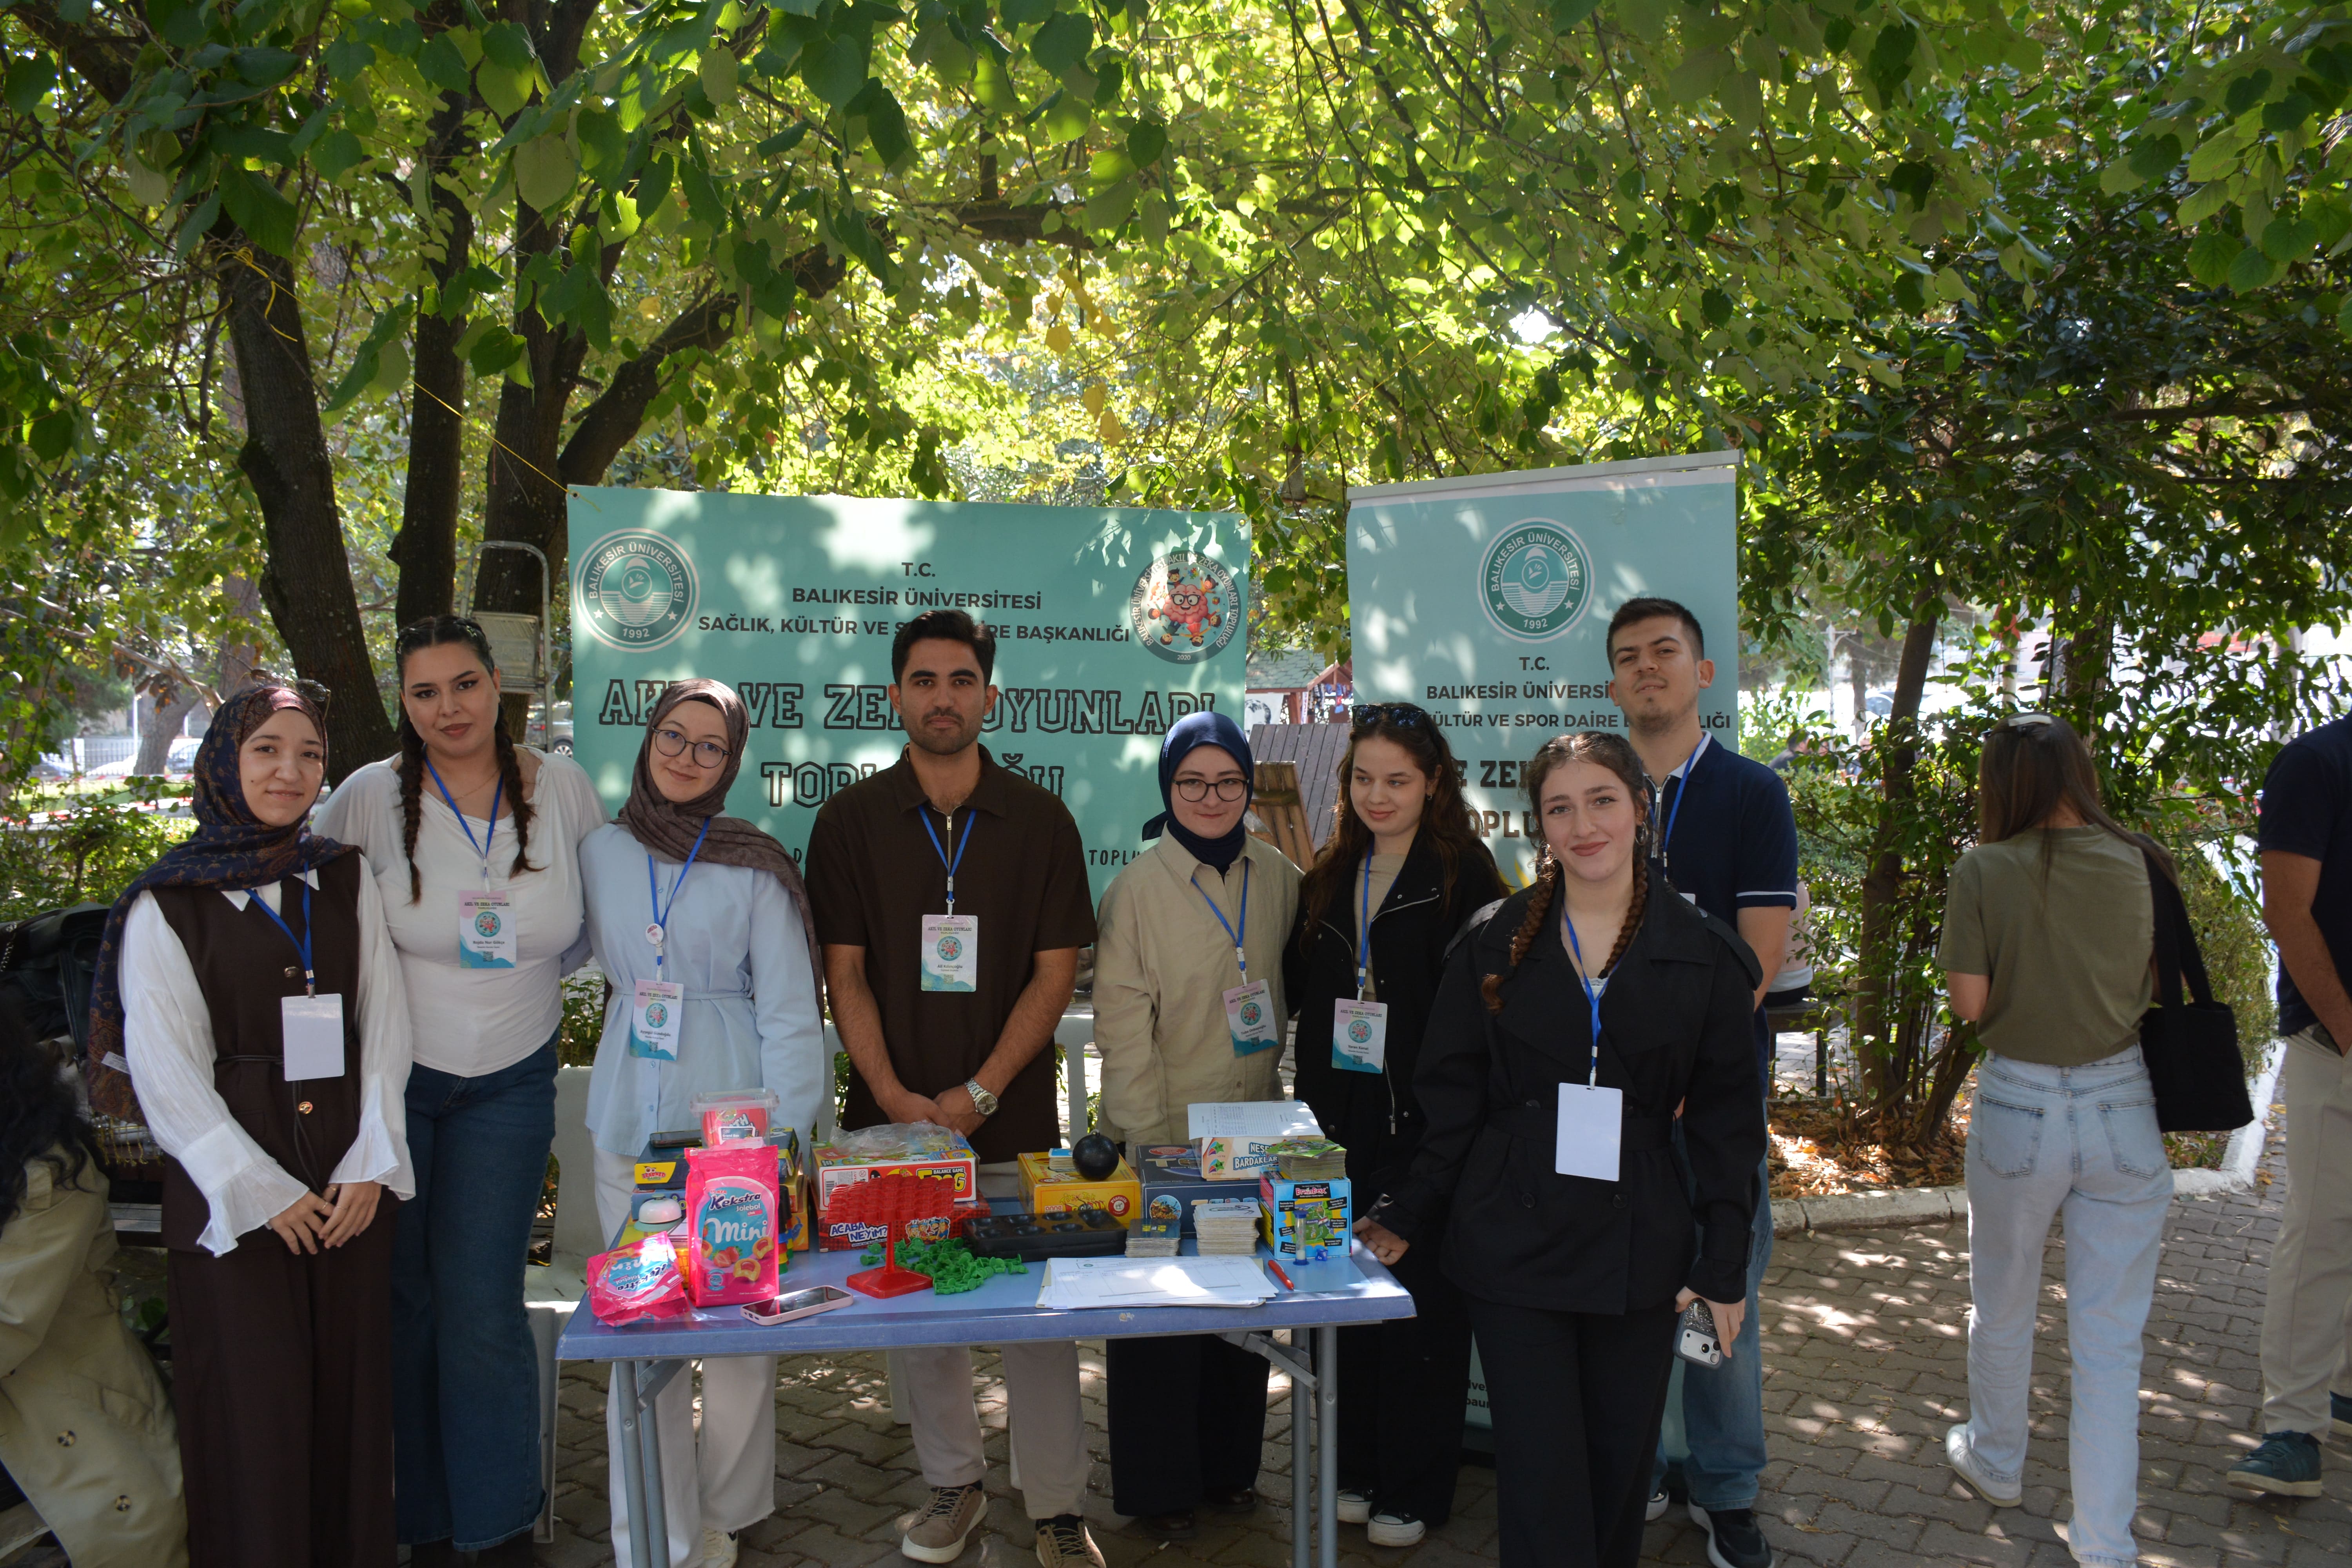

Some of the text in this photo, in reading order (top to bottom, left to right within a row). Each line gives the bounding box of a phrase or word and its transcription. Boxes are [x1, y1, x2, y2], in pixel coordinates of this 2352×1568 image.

[1168, 553, 1186, 564] AKIL
[1198, 555, 1217, 573] ZEKA
[1491, 532, 1580, 592] BALIKESİR ÜNİVERSİTESİ
[589, 541, 684, 603] BALIKESİR ÜNİVERSİTESİ
[902, 562, 936, 577] T.C.
[1217, 569, 1238, 606] OYUNLARI
[793, 586, 1041, 610] BALIKESİR ÜNİVERSİTESİ
[699, 613, 775, 634] SAĞLIK,
[781, 615, 858, 634] KÜLTÜR
[863, 621, 889, 635] VE
[1132, 606, 1154, 646] BALIKESİR
[1216, 608, 1239, 648] TOPLULUĞU
[1523, 618, 1548, 629] 1992
[622, 628, 650, 639] 1992
[1016, 624, 1129, 644] BAŞKANLIĞI
[1519, 657, 1550, 671] T.C.
[1427, 680, 1610, 699] BALIKESİR ÜNİVERSİ
[737, 682, 804, 729] VE
[824, 684, 905, 731] ZE
[1490, 714, 1510, 727] VE
[1514, 713, 1559, 727] SPOR
[1564, 710, 1618, 728] DAİRE
[1235, 1156, 1278, 1169] BARDAKLAR
[710, 1192, 762, 1210] Kekstra
[736, 1203, 761, 1212] Jolebol
[831, 1222, 865, 1235] ACABA
[849, 1226, 887, 1241] NEYİM?
